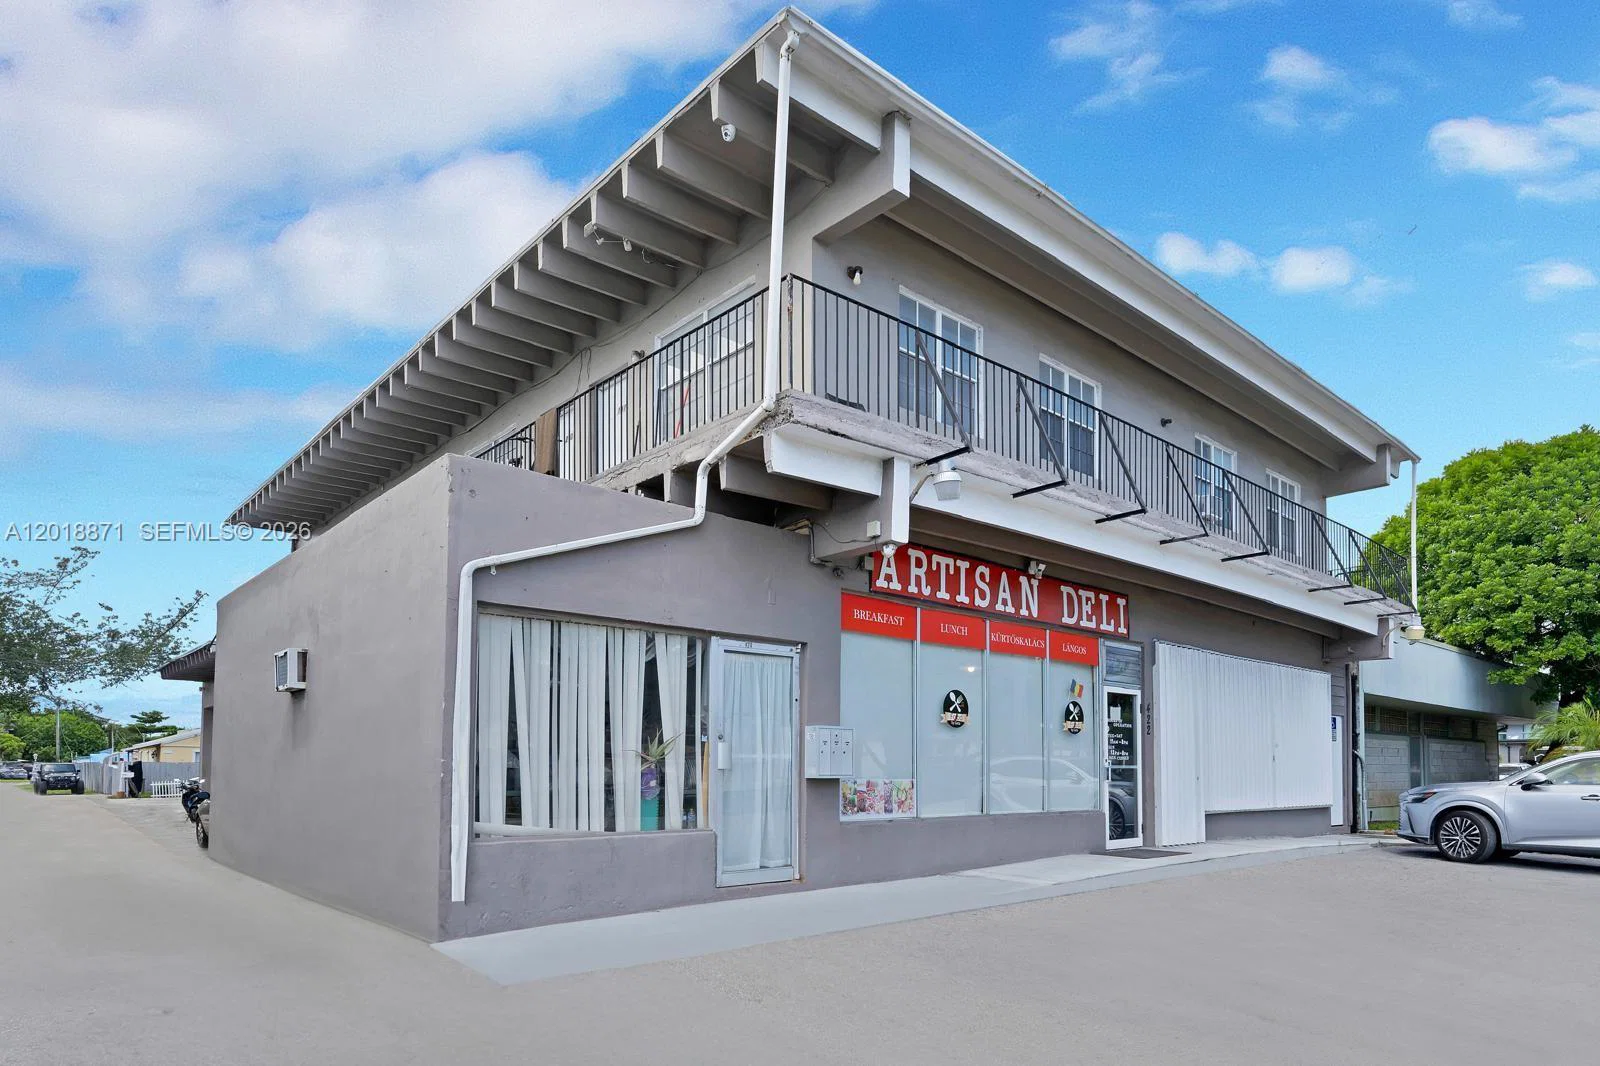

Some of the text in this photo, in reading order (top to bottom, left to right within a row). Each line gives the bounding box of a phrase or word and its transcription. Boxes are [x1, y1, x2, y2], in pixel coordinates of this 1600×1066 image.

[876, 546, 1128, 634] ARTISAN DELI
[853, 609, 905, 626] BREAKFAST
[940, 623, 968, 636] LUNCH
